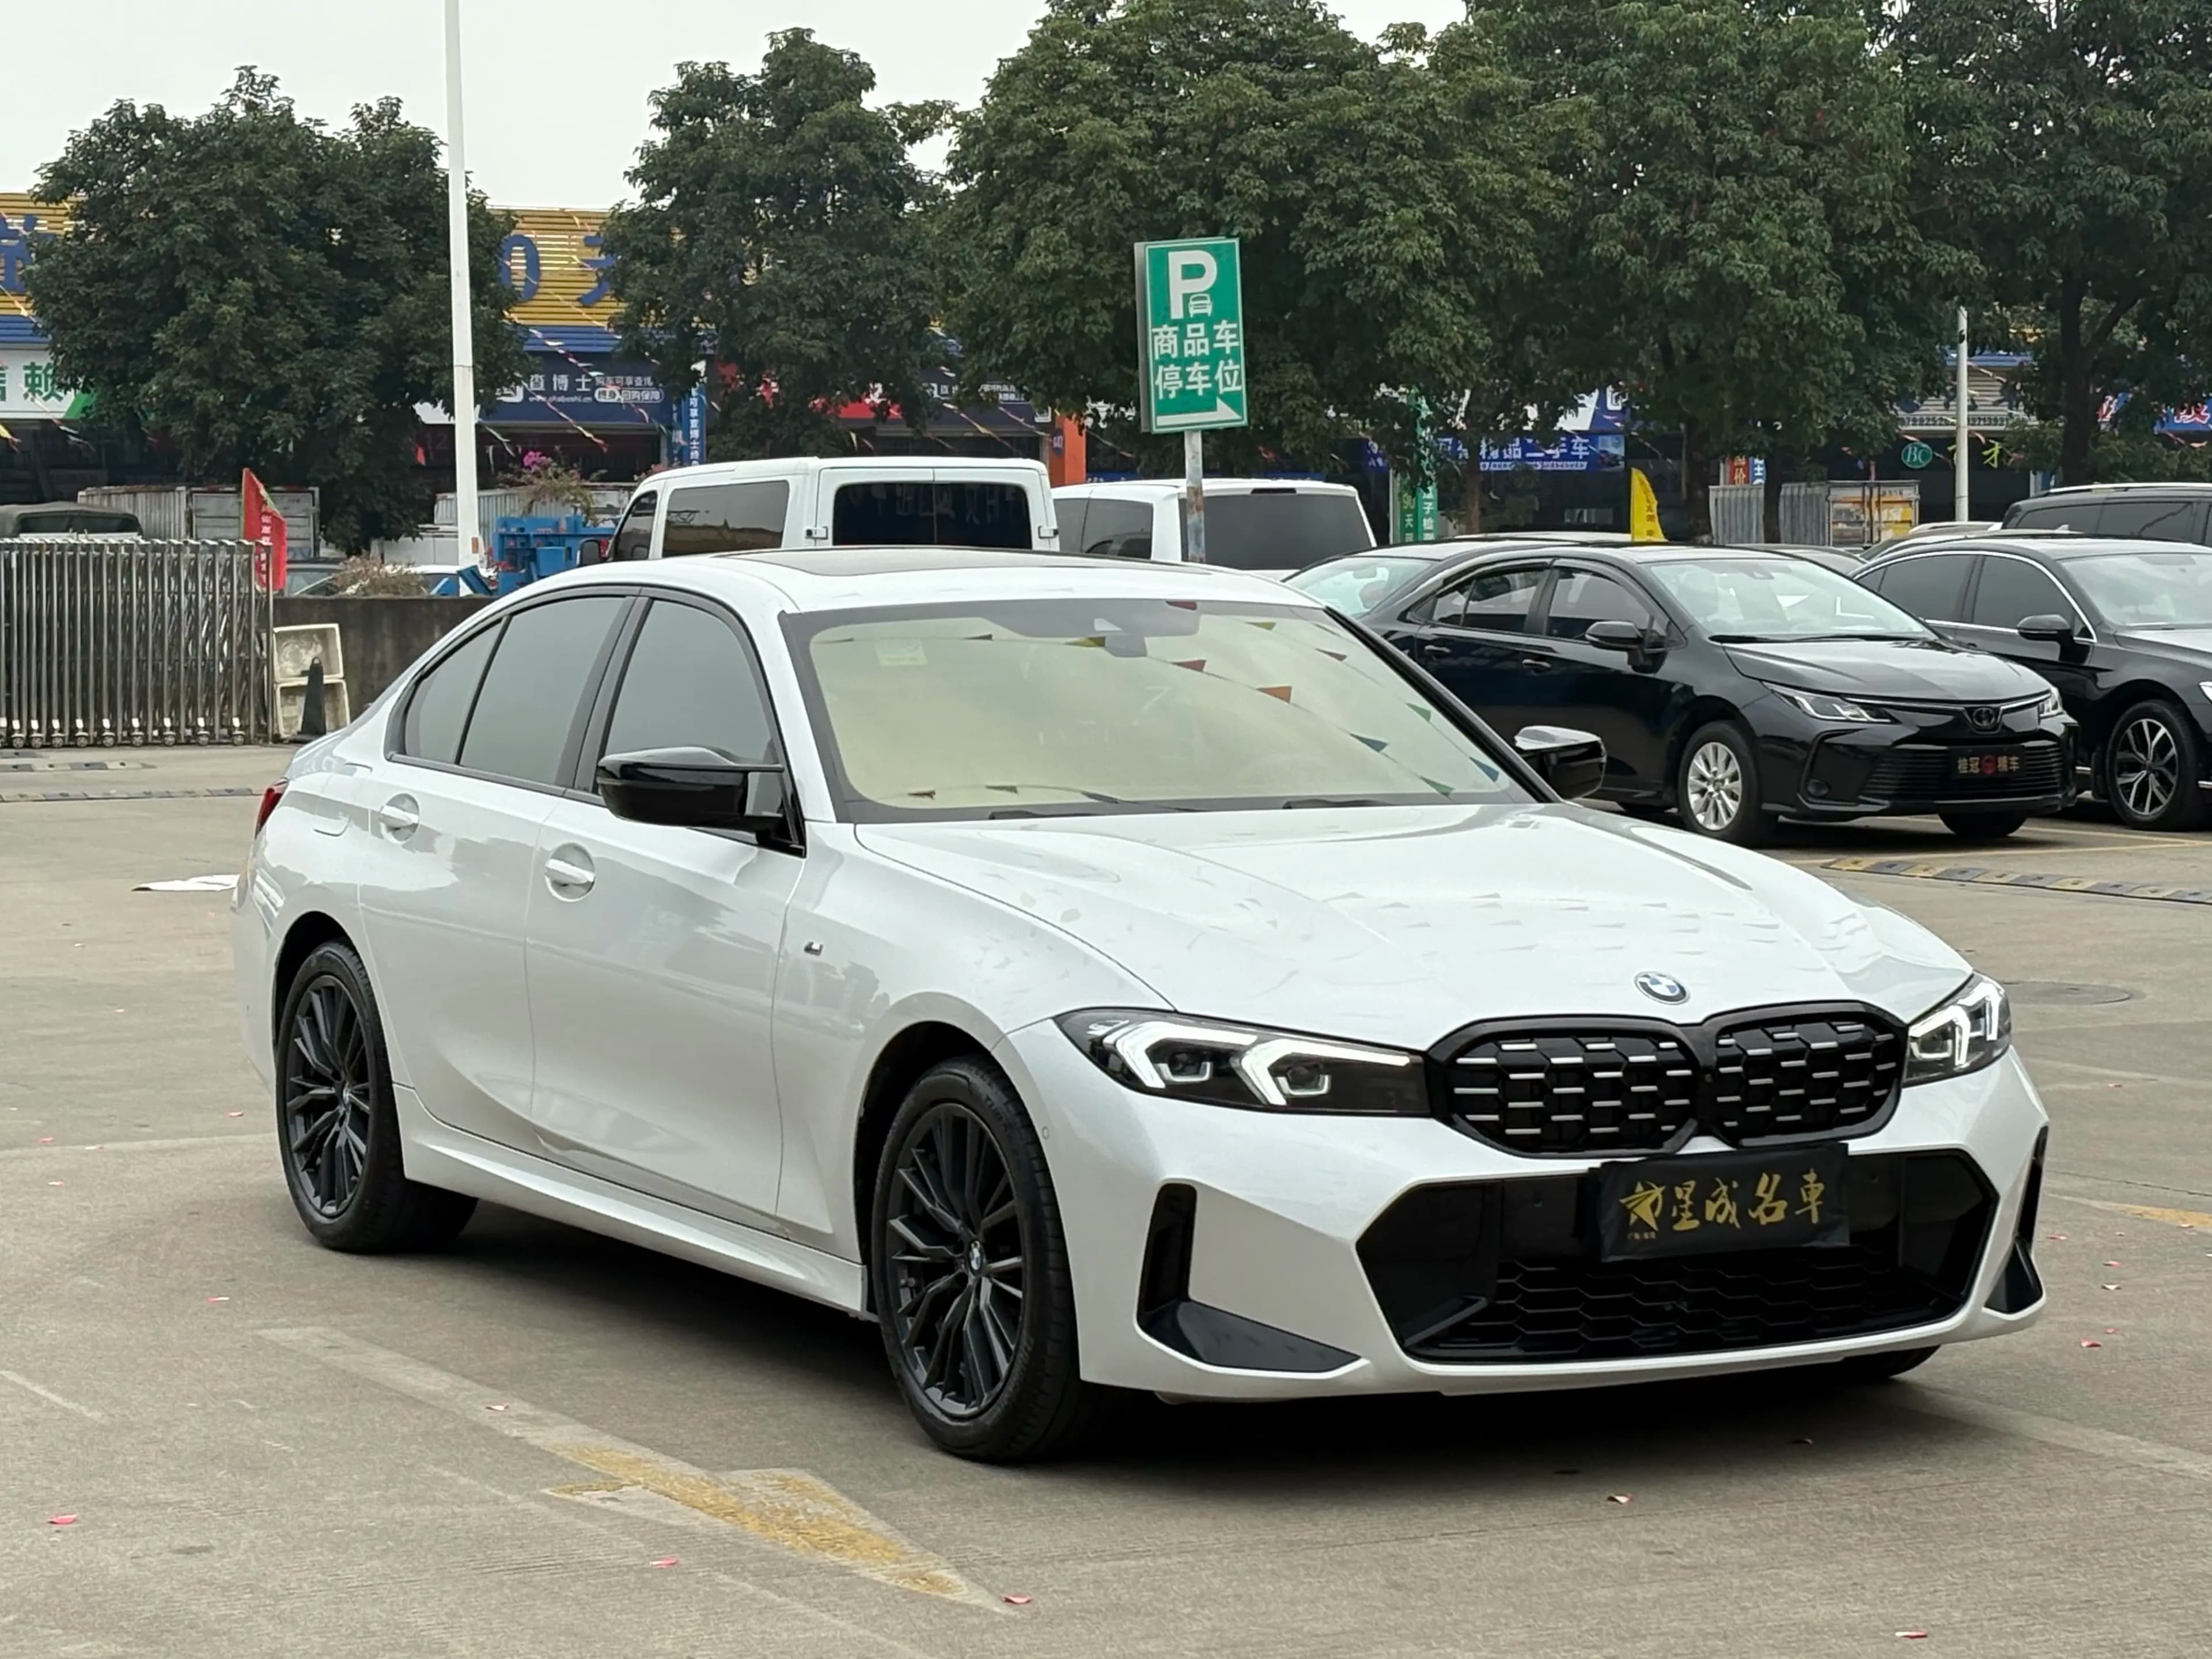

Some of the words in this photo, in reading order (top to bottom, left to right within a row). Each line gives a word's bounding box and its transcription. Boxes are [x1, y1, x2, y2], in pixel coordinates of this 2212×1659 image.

[1167, 249, 1218, 320] P
[1151, 320, 1240, 361] 商品车
[1154, 358, 1243, 400] 停车位
